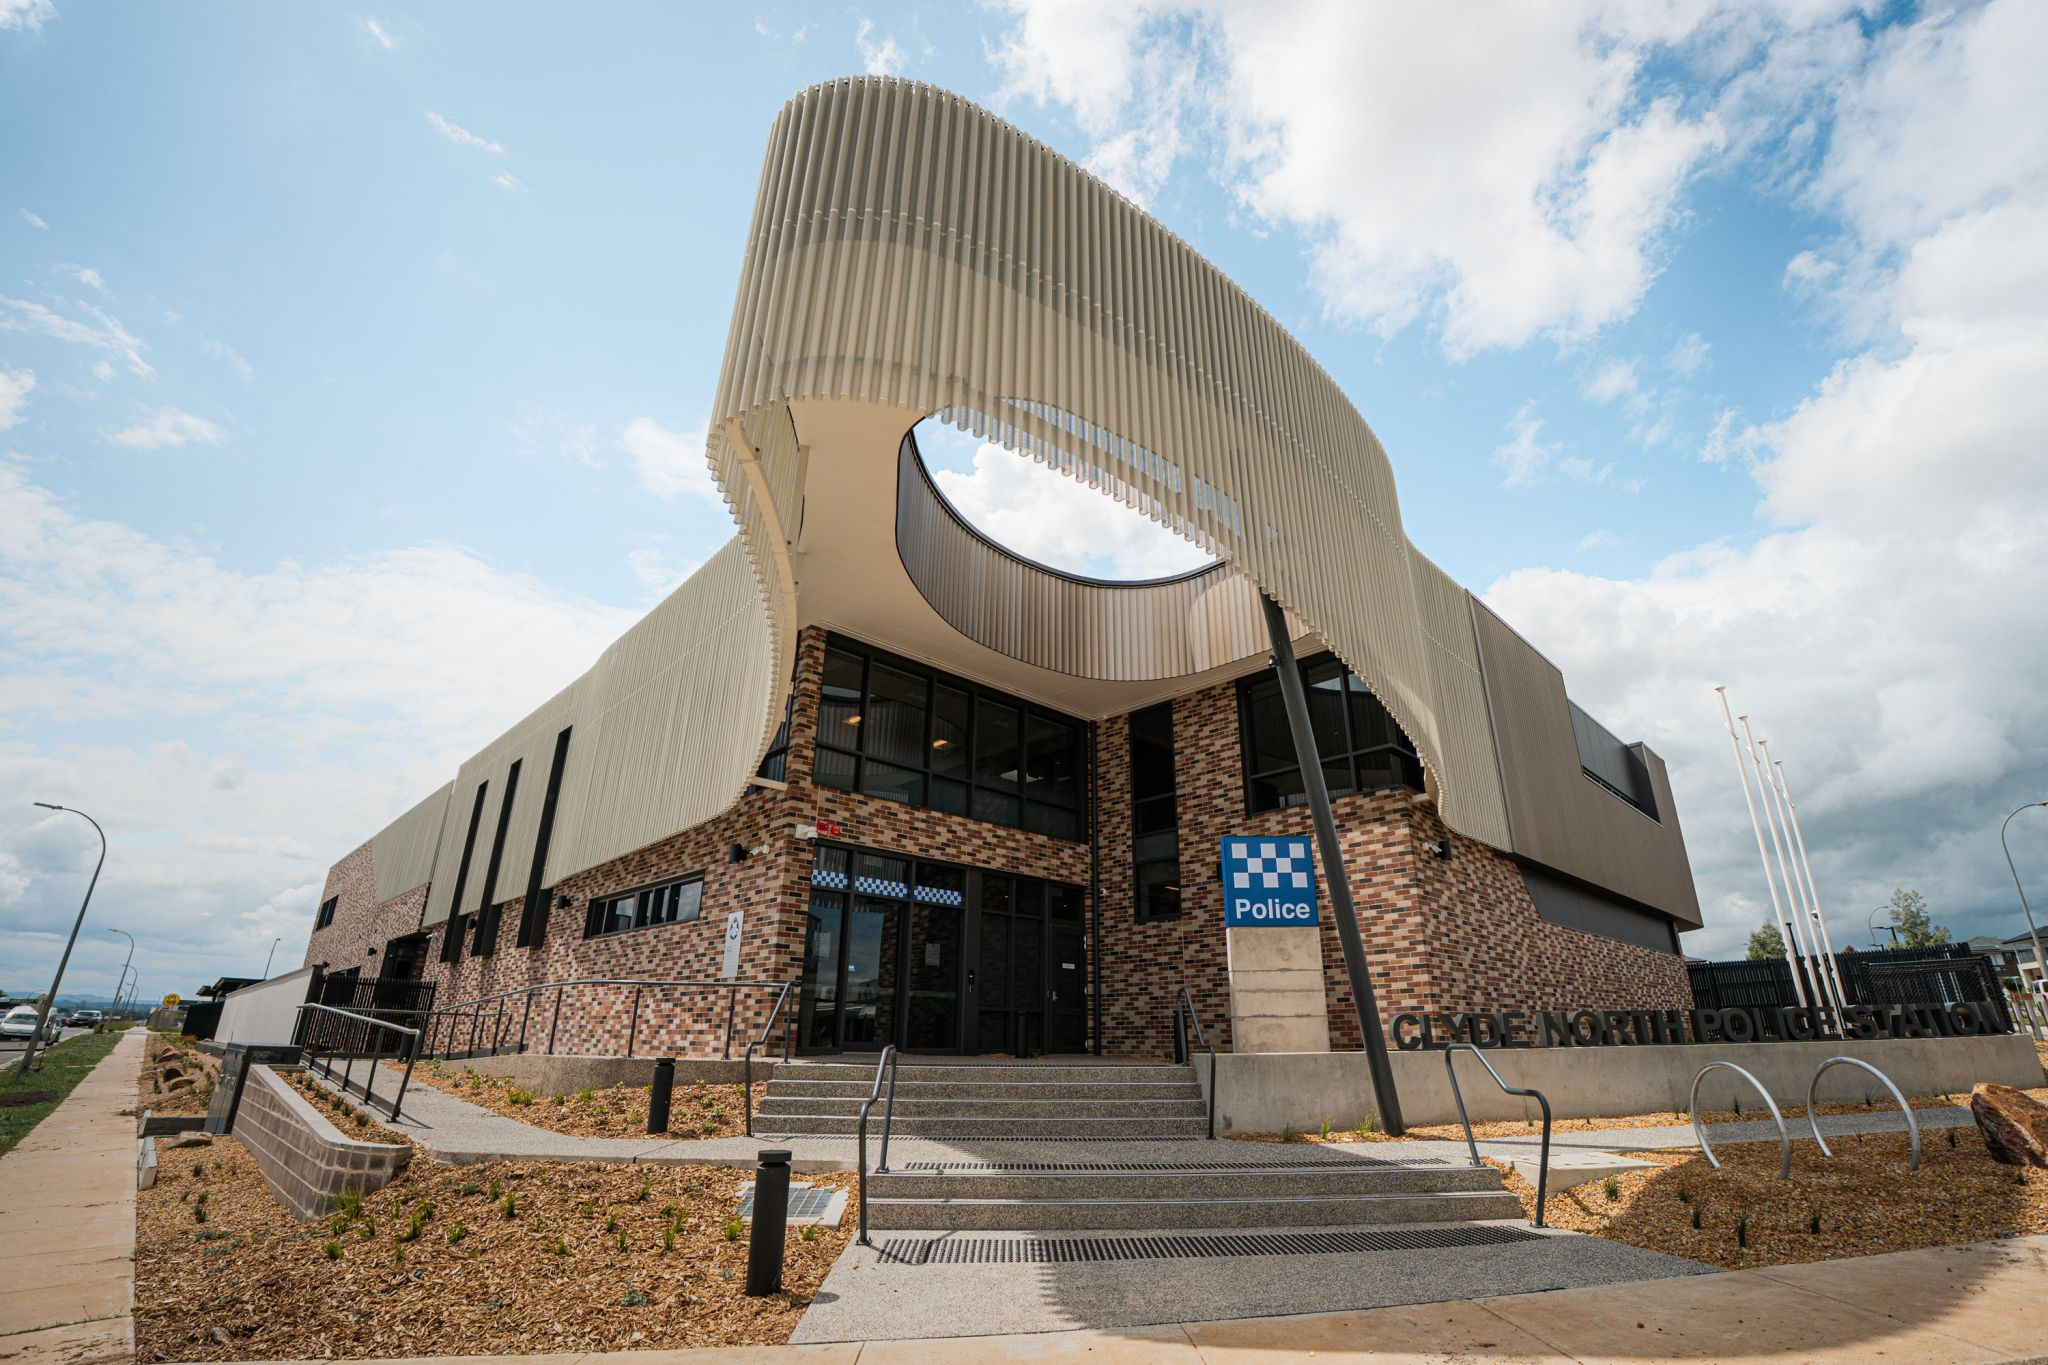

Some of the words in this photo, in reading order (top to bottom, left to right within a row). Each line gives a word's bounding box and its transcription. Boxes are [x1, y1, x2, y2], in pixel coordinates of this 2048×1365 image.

[1235, 898, 1310, 919] Police
[1389, 1012, 1531, 1050] CLYDE
[1536, 1009, 1683, 1047] NORTH
[1690, 1006, 1842, 1042] POLICE
[1843, 1001, 2010, 1039] STATION
